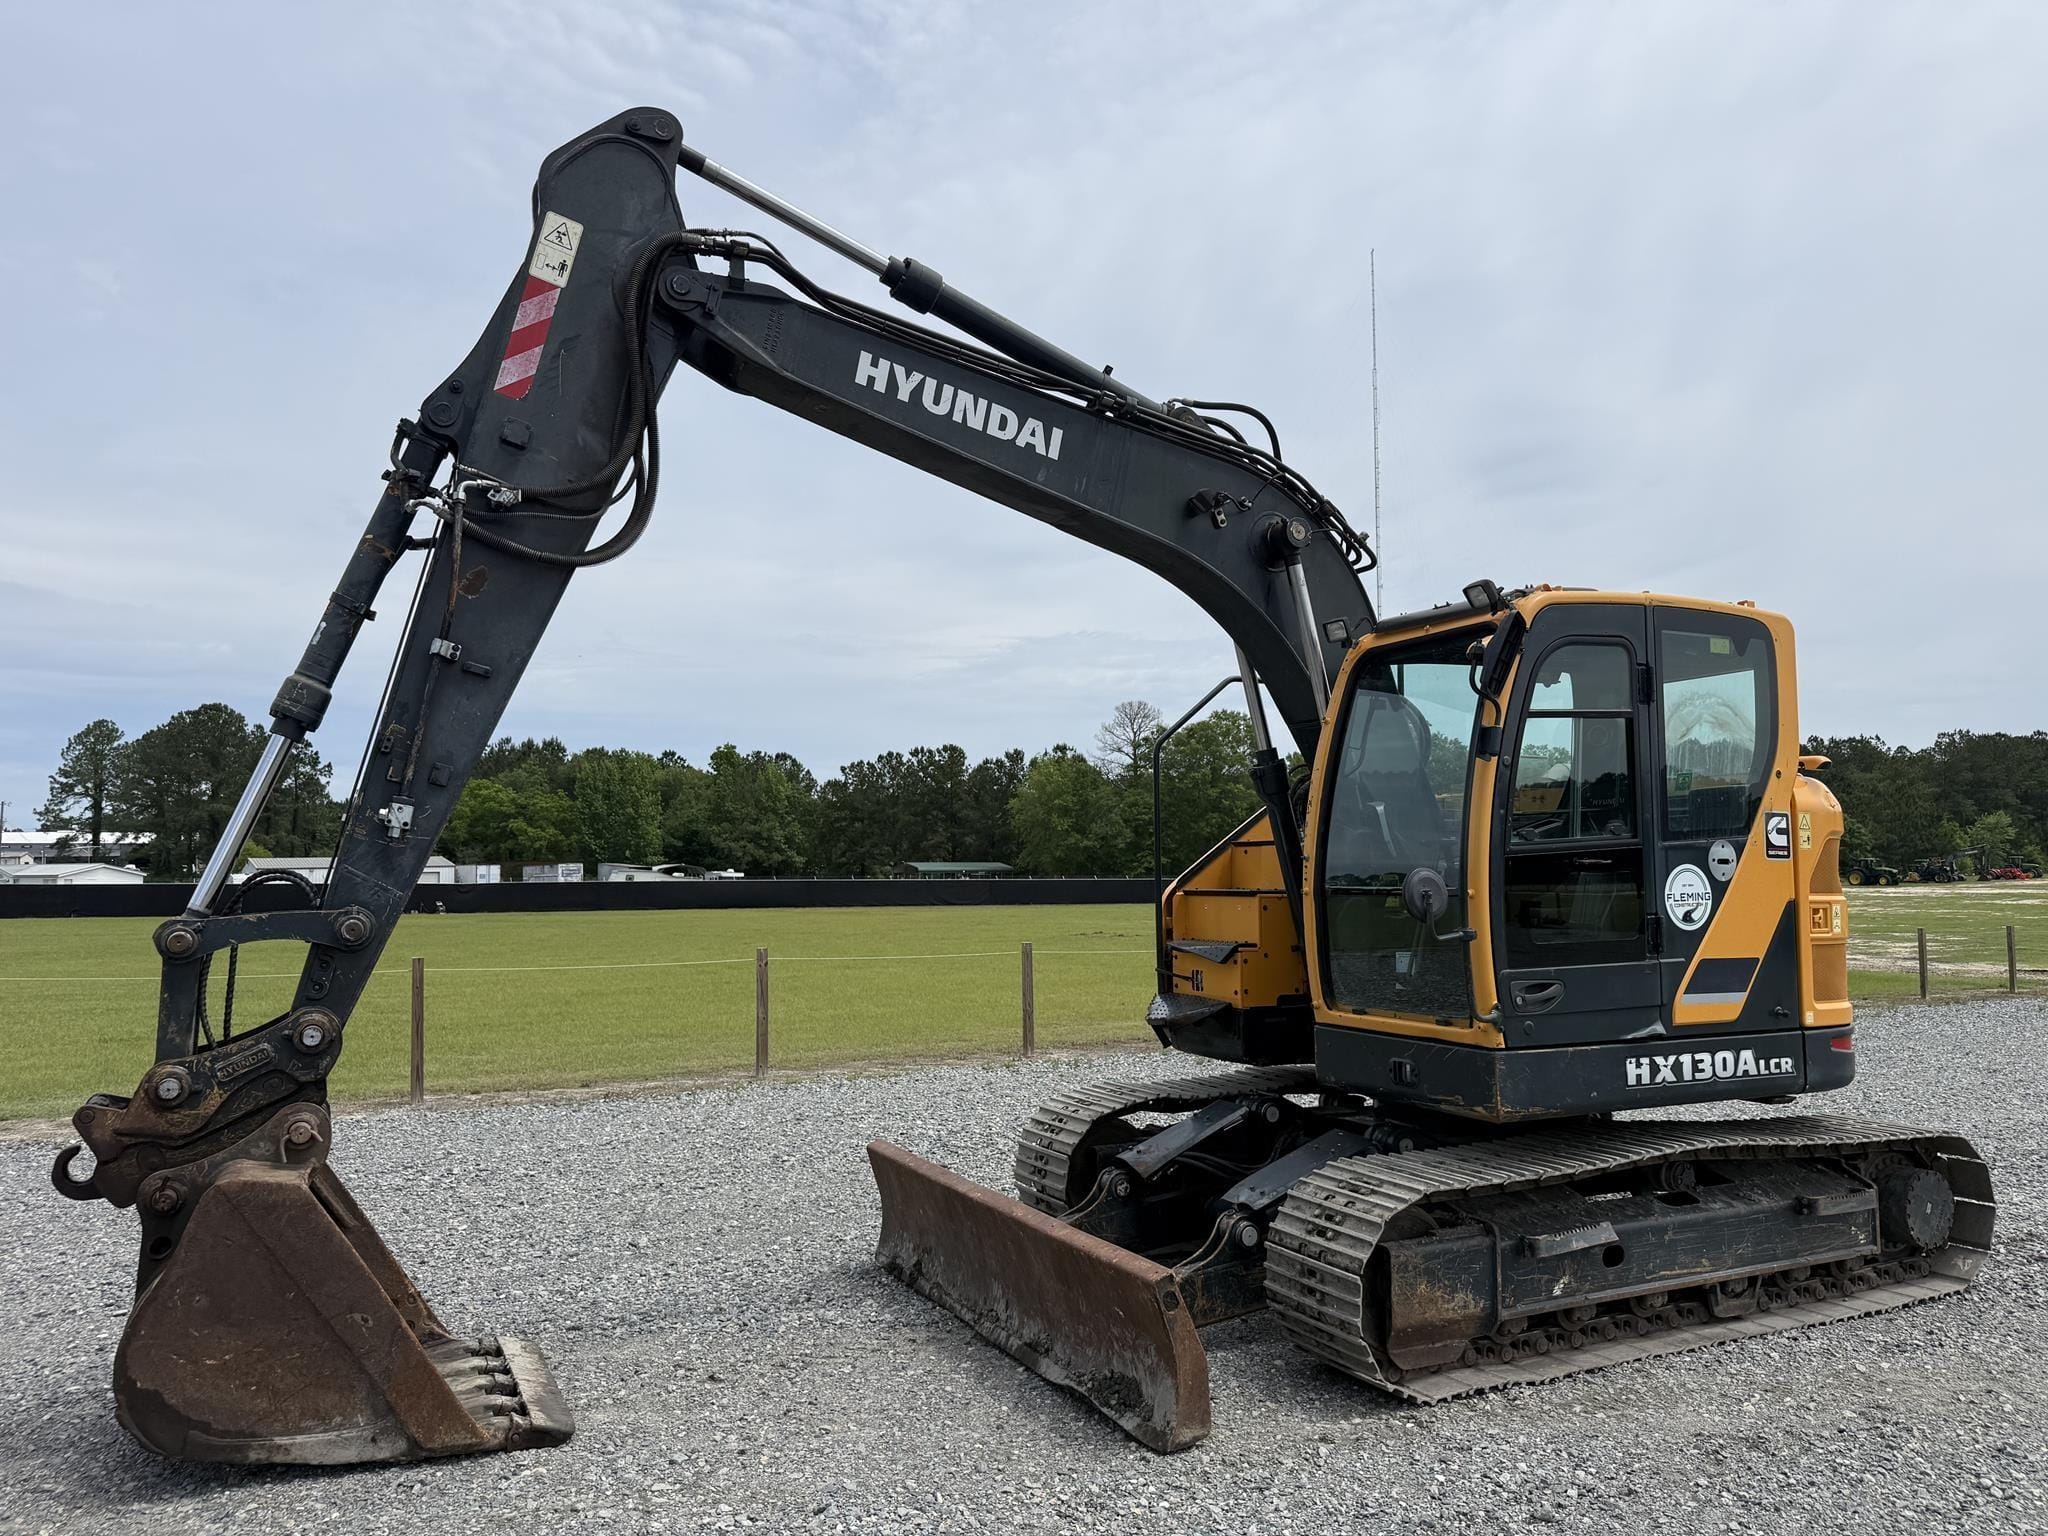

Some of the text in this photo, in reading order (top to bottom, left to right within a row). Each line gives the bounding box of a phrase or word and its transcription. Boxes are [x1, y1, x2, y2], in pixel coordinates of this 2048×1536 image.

[855, 350, 1063, 460] HYUNDAI
[1666, 891, 1711, 902] FLEMING
[219, 1048, 269, 1080] HYUNDAI
